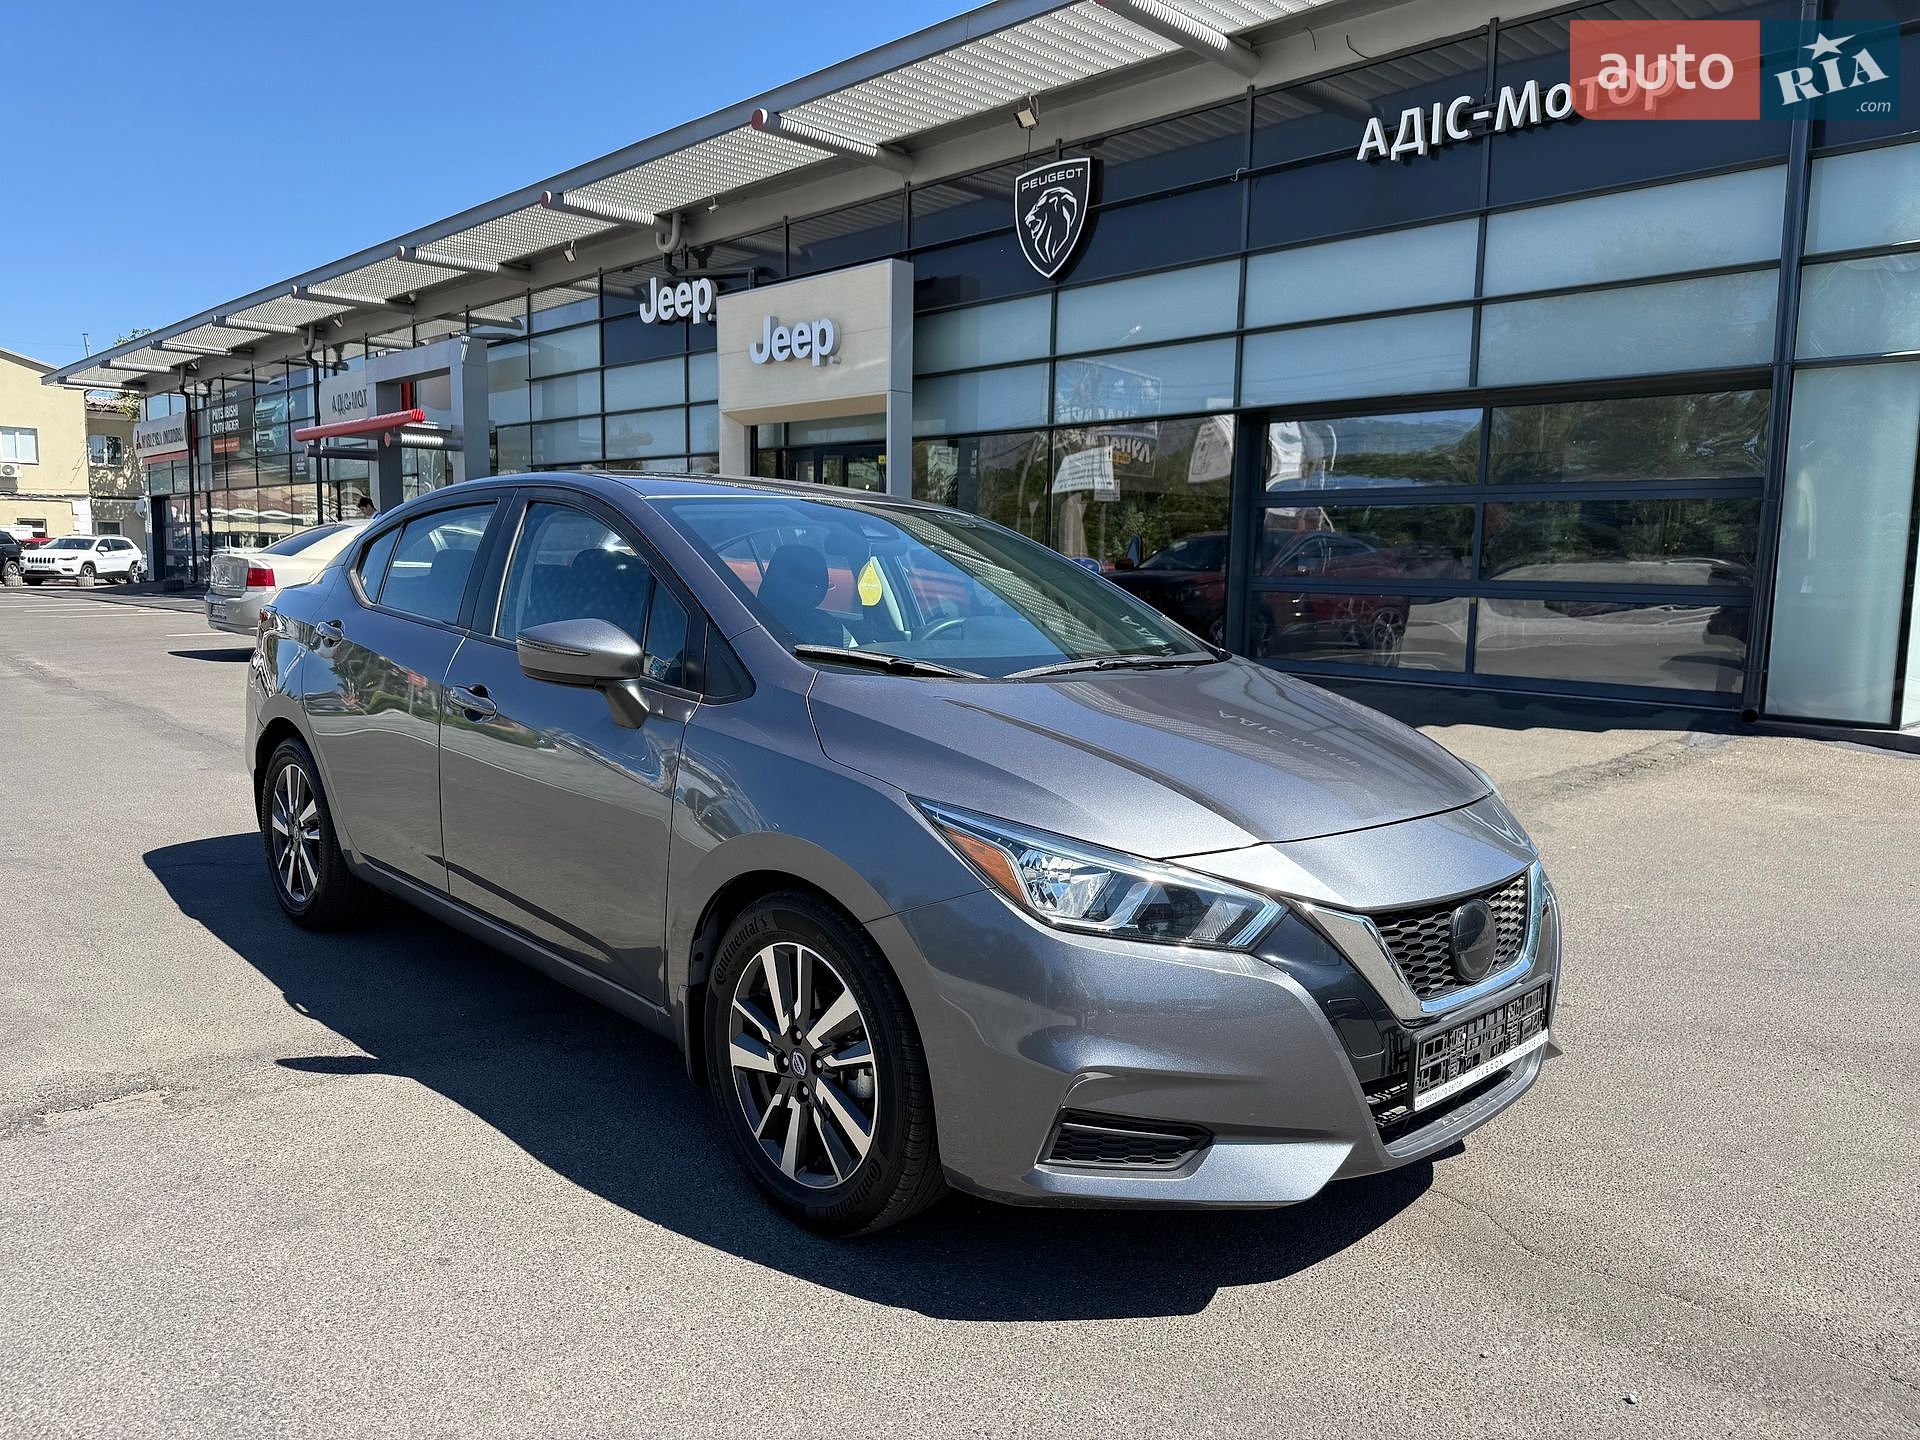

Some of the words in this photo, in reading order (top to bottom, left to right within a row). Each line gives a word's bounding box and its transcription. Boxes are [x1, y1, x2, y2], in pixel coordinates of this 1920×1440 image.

[1021, 168, 1084, 193] PEUGEOT
[639, 277, 713, 324] Jeep
[750, 315, 837, 367] Jeep
[211, 404, 239, 420] MITSBISHI
[331, 389, 368, 416] АДІС-МОТ
[714, 916, 760, 986] Continental
